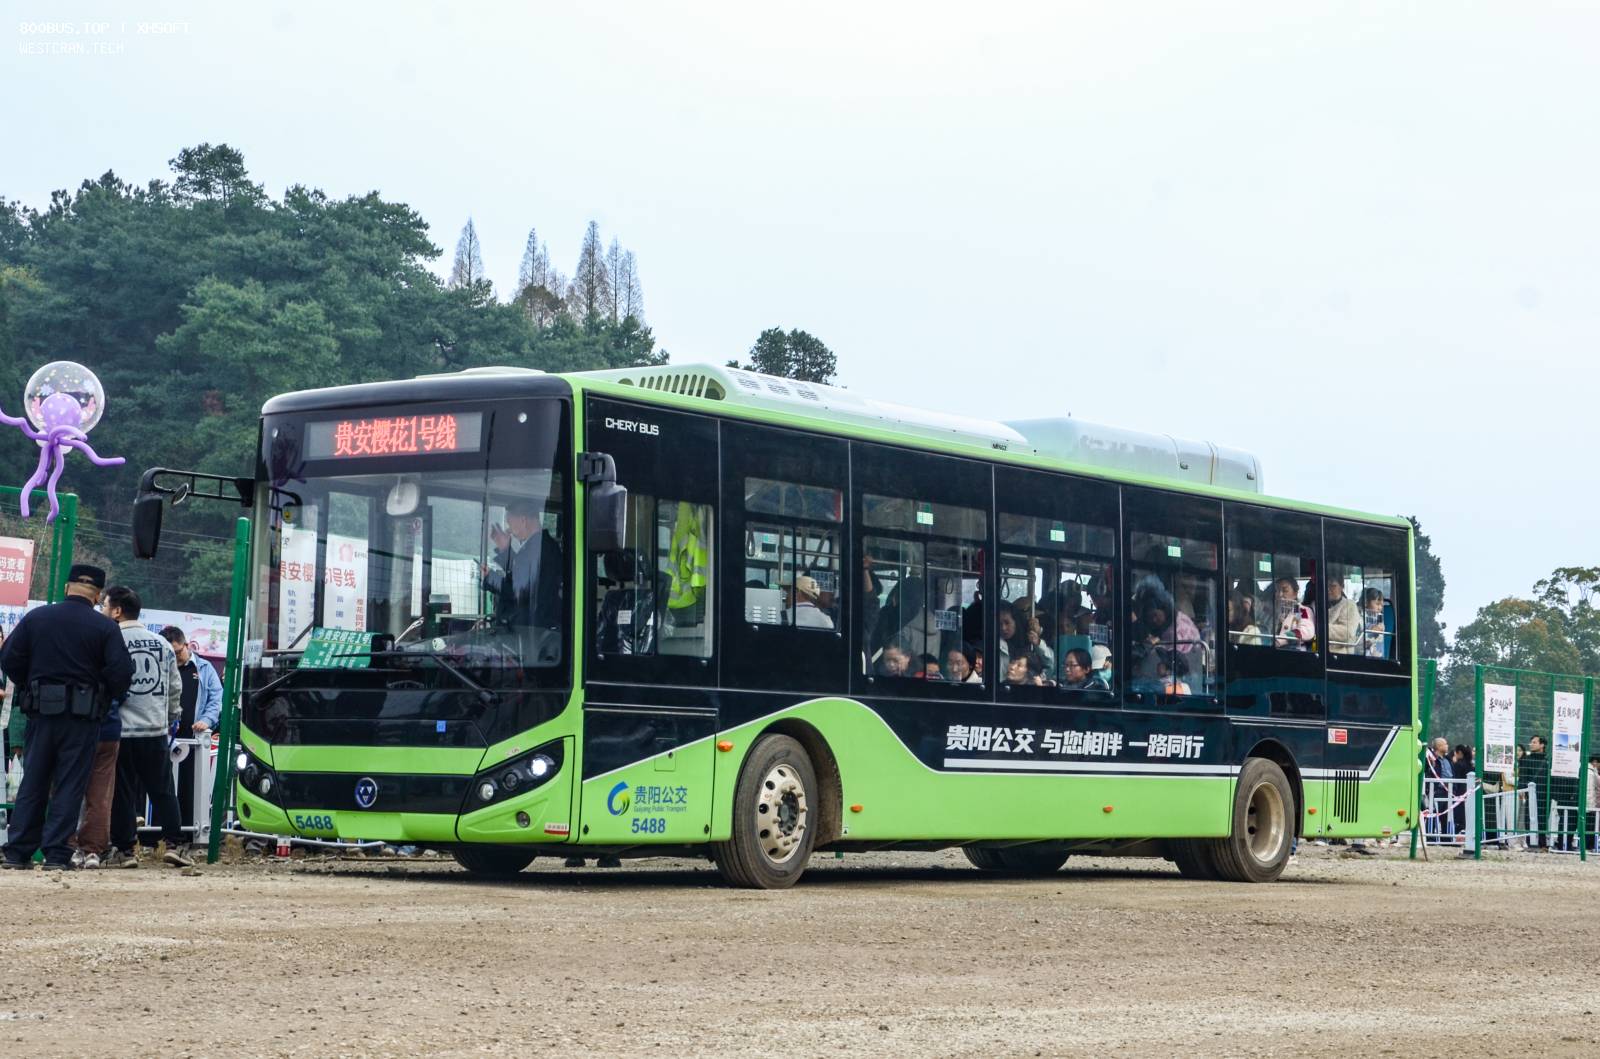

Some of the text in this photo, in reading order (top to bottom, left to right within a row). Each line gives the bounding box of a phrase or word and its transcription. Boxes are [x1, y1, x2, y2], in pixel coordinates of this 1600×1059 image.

[334, 414, 456, 456] 贵安樱花1号线
[605, 417, 660, 436] CHERY BUS
[946, 725, 1205, 758] 贵阳公交 与您相伴 一路同行
[634, 786, 688, 804] 贵阳公交
[296, 815, 333, 830] 5488
[632, 818, 666, 833] 5488
